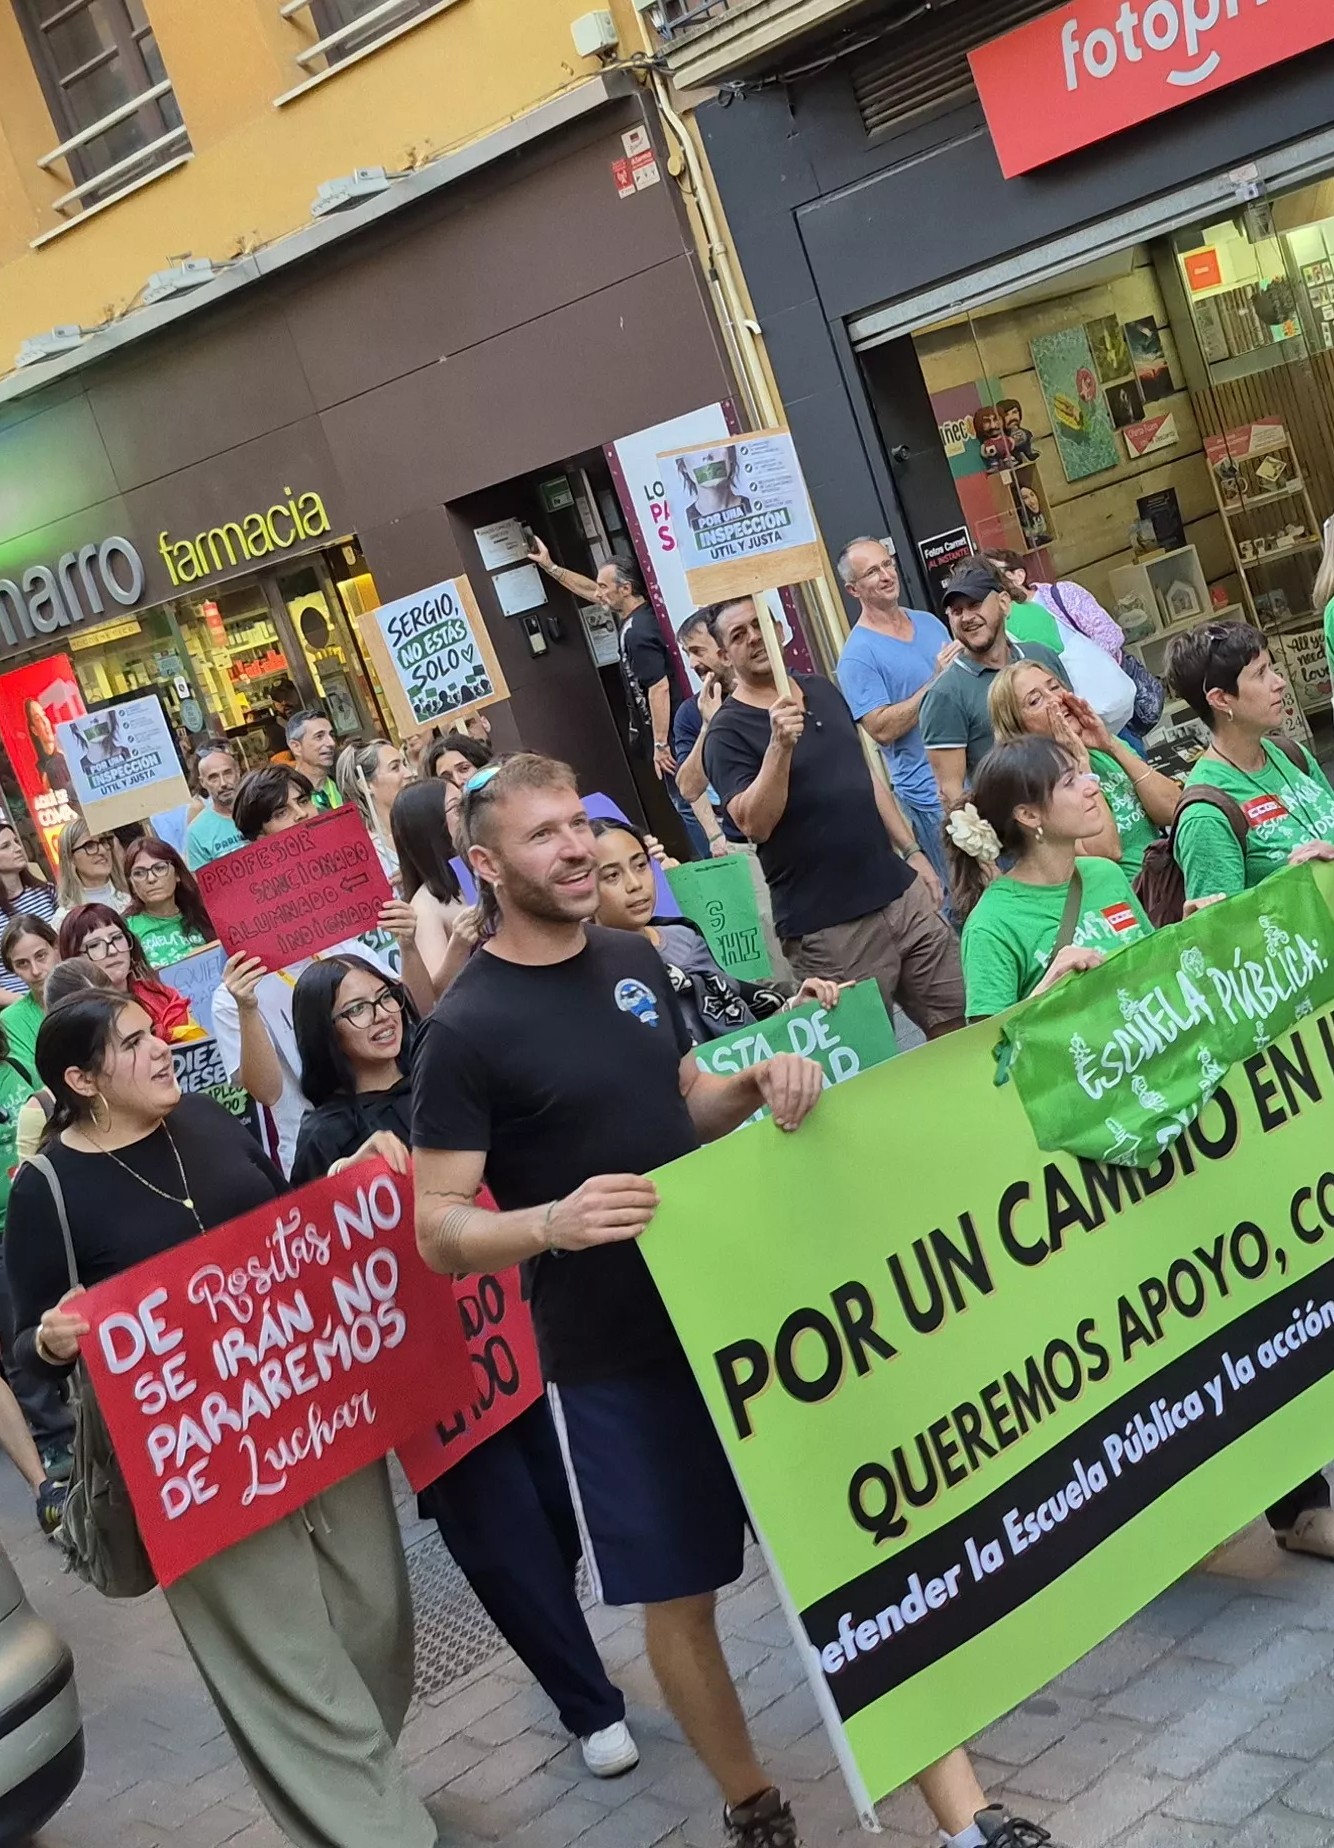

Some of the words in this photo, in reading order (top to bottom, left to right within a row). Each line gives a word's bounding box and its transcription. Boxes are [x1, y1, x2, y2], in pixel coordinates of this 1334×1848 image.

[158, 486, 331, 586] farmacia
[698, 514, 721, 530] POR
[722, 508, 744, 523] UNA
[698, 509, 787, 549] INSPECCIÓN
[738, 541, 747, 552] Y
[747, 531, 782, 550] JUSTA
[387, 592, 459, 648] SERGIO,
[399, 643, 423, 667] NO
[425, 620, 467, 651] ESTÁS
[411, 649, 460, 691] SOLO
[1297, 645, 1326, 666] need
[91, 751, 159, 787] INSPECCIÓN
[129, 771, 156, 785] JUSTA
[202, 831, 317, 894] PROFESOR
[250, 841, 370, 904] SANCIONADO
[229, 886, 339, 946] ALUMNADO
[786, 1009, 842, 1059] DE
[1075, 969, 1216, 1100] ESCUELA
[712, 1280, 899, 1441] POR
[885, 1209, 996, 1334] UN
[1243, 1031, 1323, 1133] EN
[99, 1286, 184, 1376] DE
[187, 1206, 332, 1325] Rositas
[332, 1174, 402, 1251] NO
[134, 1351, 198, 1416] SE
[330, 1247, 398, 1326] NO
[146, 1300, 408, 1477] PARAREMOS
[847, 1317, 1111, 1545] QUEREMOS
[1117, 1220, 1287, 1362] APOYO,
[160, 1457, 219, 1522] DE
[239, 1388, 377, 1506] Luchar
[816, 1563, 962, 1674] efender
[964, 1537, 1005, 1583] la
[1001, 1459, 1109, 1556] Escuela
[1102, 1388, 1206, 1478] Pública
[1202, 1373, 1225, 1417] y
[1221, 1351, 1257, 1391] la
